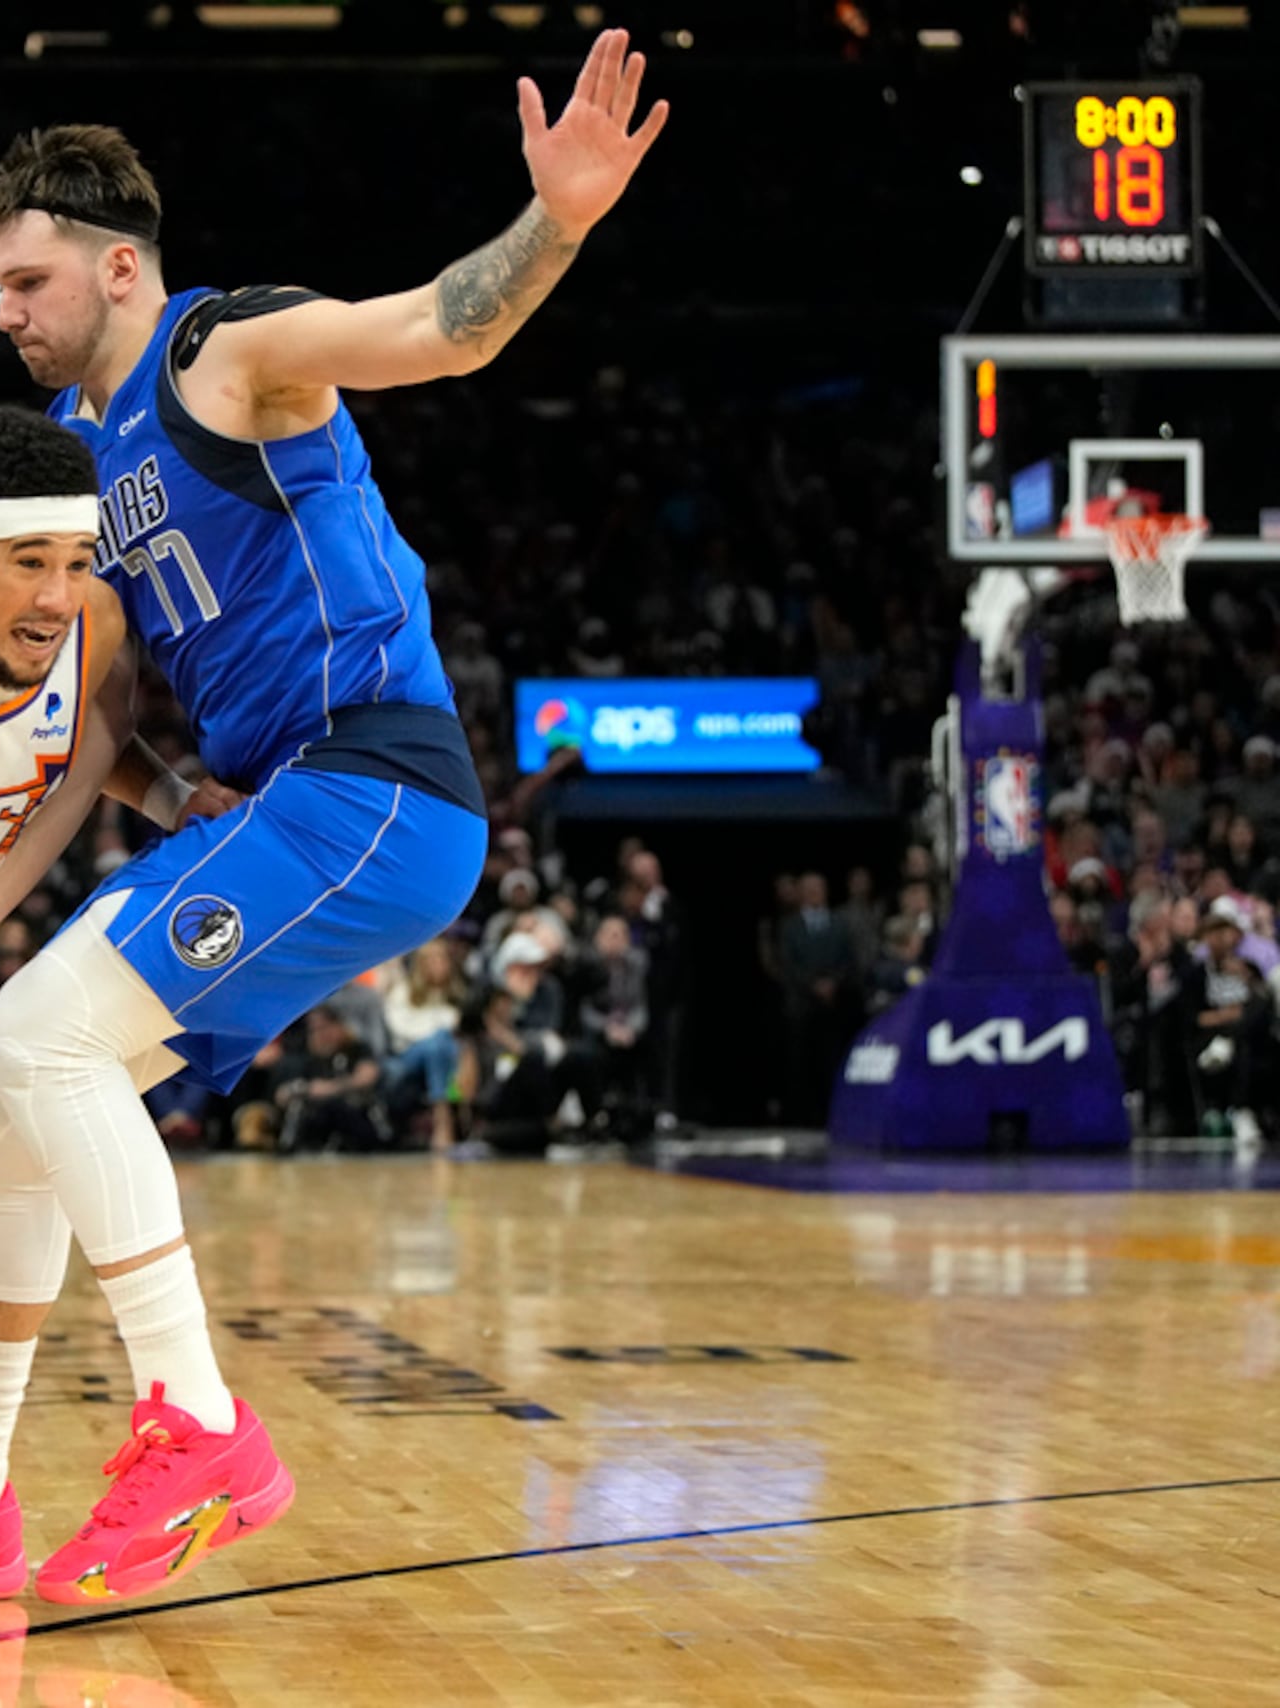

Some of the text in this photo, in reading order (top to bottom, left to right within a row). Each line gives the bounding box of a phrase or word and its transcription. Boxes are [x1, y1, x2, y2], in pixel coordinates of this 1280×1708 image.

[1075, 96, 1177, 148] 8:00
[1093, 145, 1165, 227] 18
[120, 528, 221, 637] 77
[591, 706, 677, 752] aps
